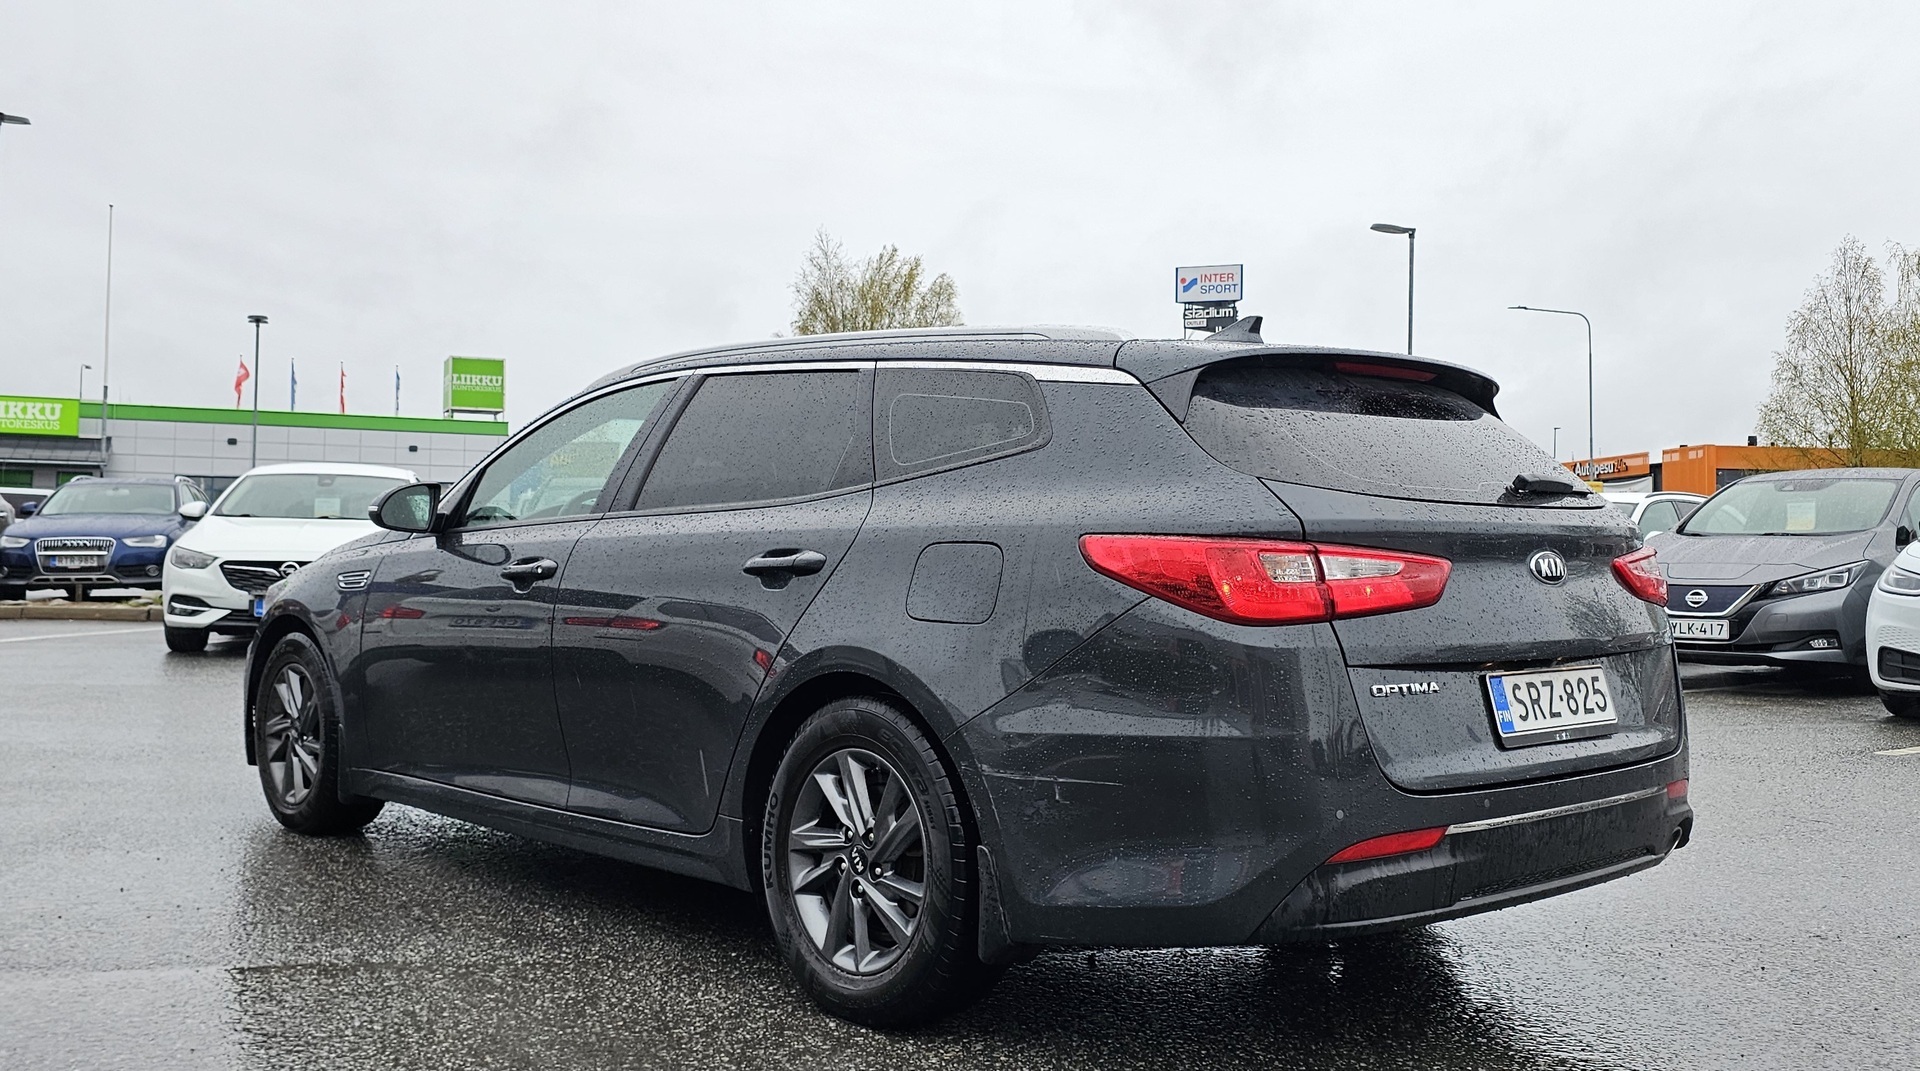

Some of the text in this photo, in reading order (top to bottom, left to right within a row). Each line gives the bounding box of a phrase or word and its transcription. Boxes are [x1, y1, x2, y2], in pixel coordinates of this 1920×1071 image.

[1200, 273, 1235, 283] INTER
[1200, 284, 1238, 294] SPORT
[1185, 307, 1233, 318] stadium
[452, 373, 503, 387] LIIKKU
[1537, 558, 1564, 577] KIA
[1671, 622, 1724, 635] YLK-417
[1370, 681, 1440, 697] OPTIMA
[1512, 676, 1607, 722] SRZ-825
[1498, 710, 1512, 723] FIN
[763, 792, 779, 889] KUMHO
